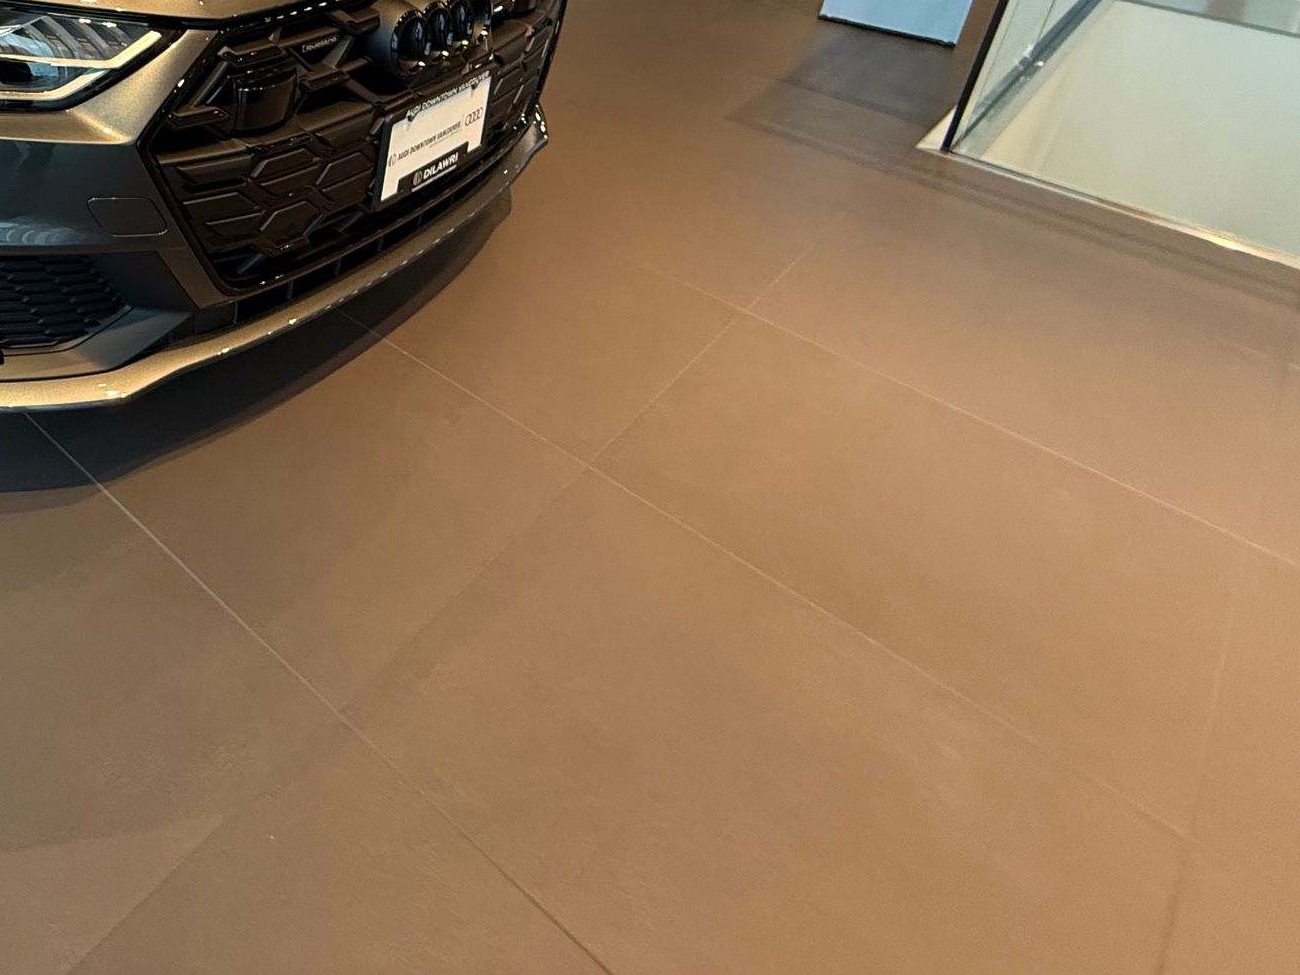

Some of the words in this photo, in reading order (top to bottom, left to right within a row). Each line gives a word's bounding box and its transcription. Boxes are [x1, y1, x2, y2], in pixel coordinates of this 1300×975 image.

[397, 148, 409, 161] AUDI
[409, 135, 437, 155] DOWNTOWN
[437, 121, 461, 139] VANCOUVER
[423, 152, 459, 179] DILAWRI
